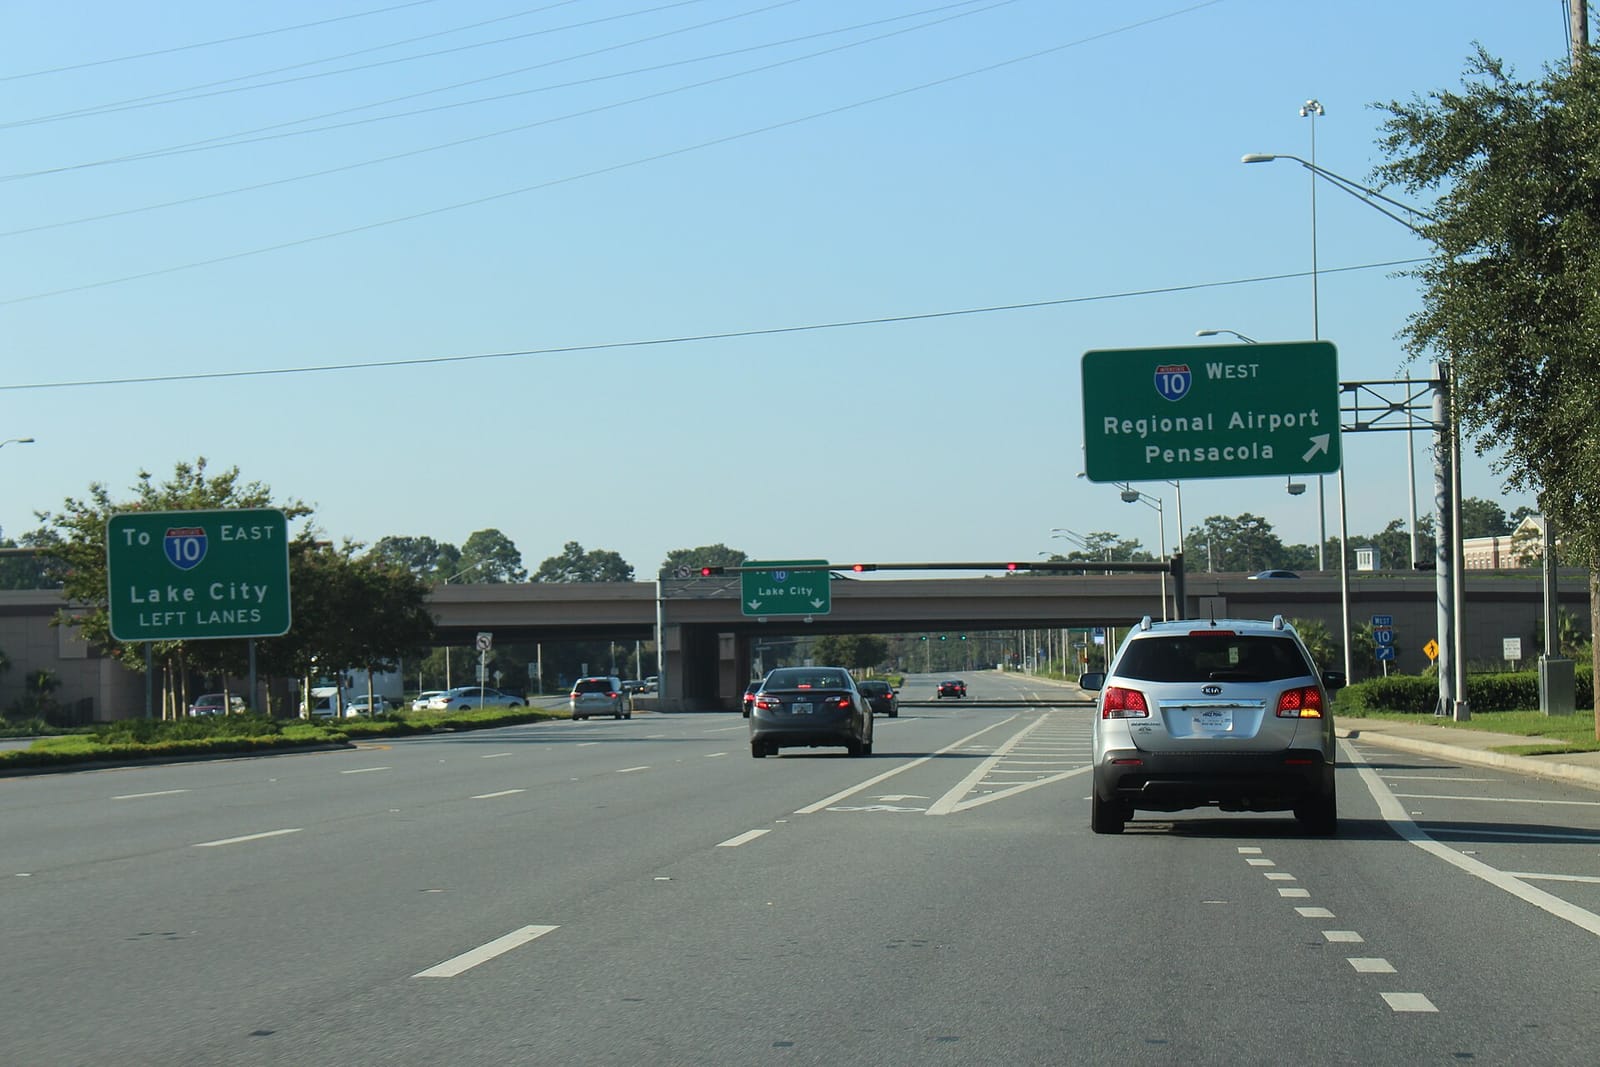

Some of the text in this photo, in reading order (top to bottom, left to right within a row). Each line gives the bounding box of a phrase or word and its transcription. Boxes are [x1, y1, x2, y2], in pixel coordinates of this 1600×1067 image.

[1162, 362, 1259, 394] 10 WEST
[1104, 409, 1319, 438] Regional Airport
[1145, 442, 1274, 463] Pensacola
[122, 525, 275, 561] To 10 EAST
[775, 571, 786, 579] 10
[131, 582, 268, 603] Lake City
[759, 586, 813, 597] Lake City
[139, 609, 262, 626] LEFT LANES
[1378, 632, 1390, 643] 10
